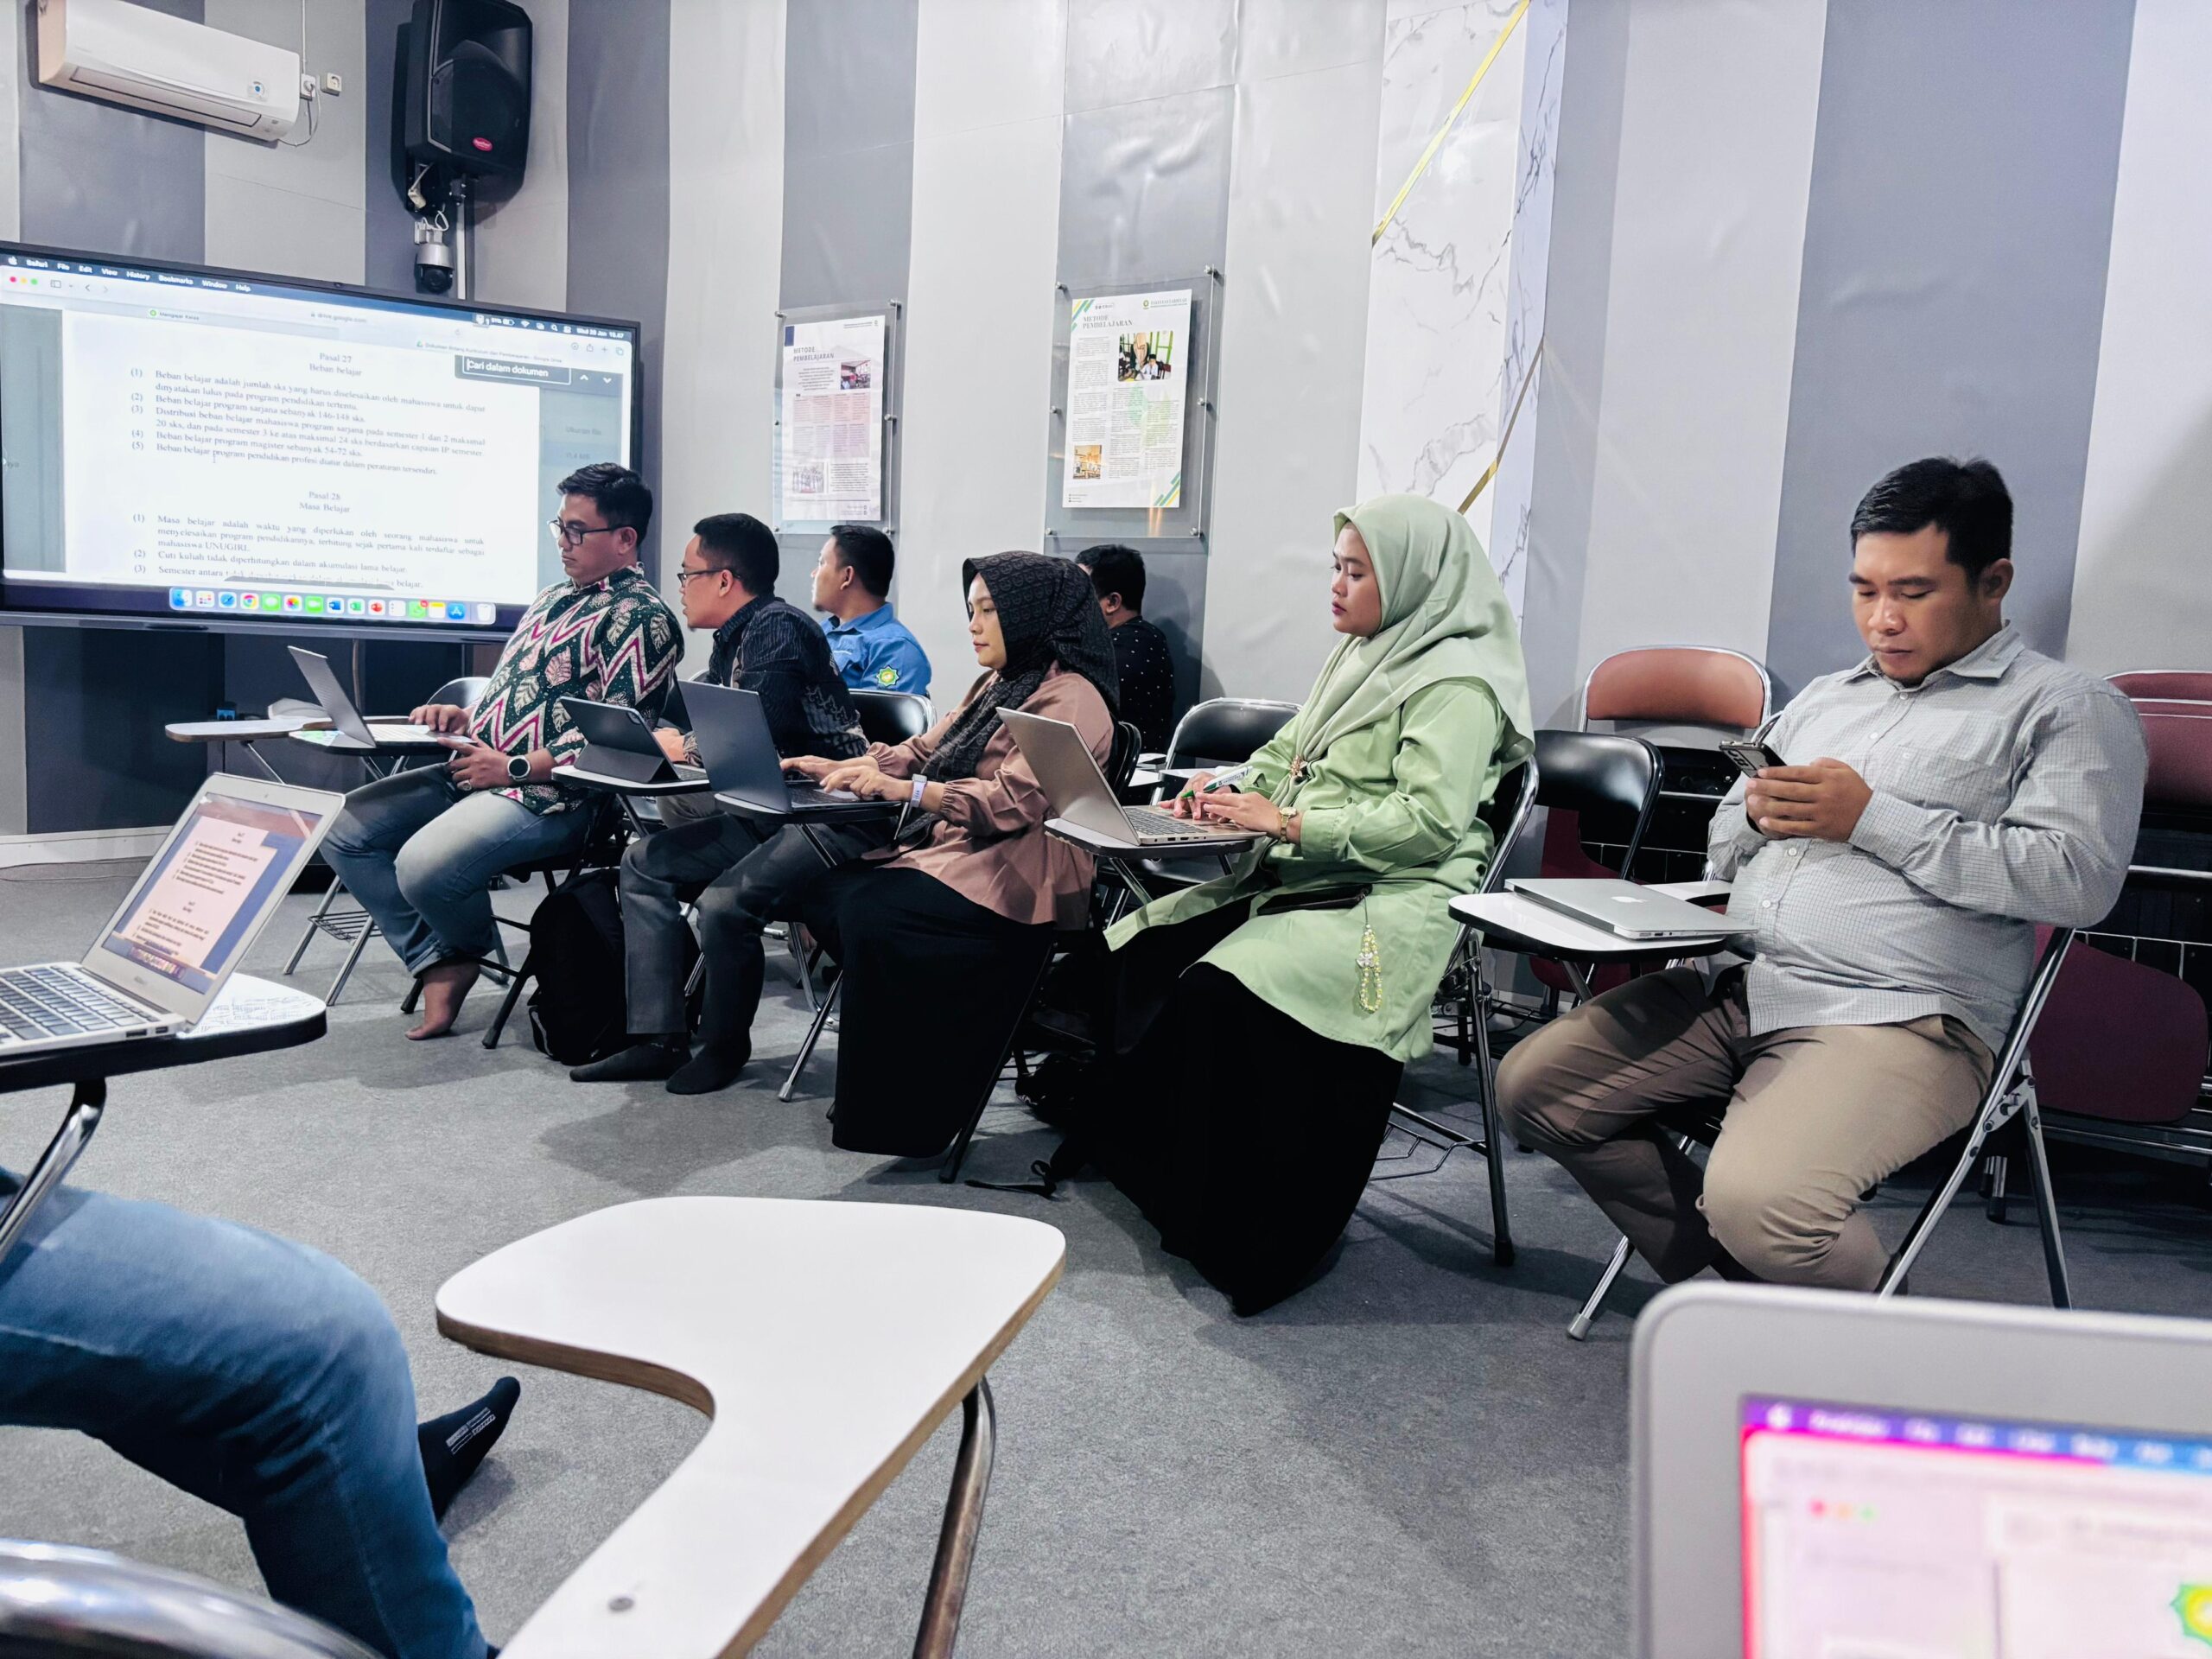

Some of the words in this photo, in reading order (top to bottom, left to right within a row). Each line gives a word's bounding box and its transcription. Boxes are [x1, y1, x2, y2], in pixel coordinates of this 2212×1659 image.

[26, 259, 48, 268] Safari
[126, 270, 150, 281] History
[158, 274, 194, 285] Bookmarks
[201, 279, 228, 289] Window
[235, 283, 251, 292] Help
[1083, 320, 1133, 328] PEMBELAJARAN
[319, 353, 340, 363] Pasal
[468, 359, 484, 370] Cari
[486, 363, 510, 373] dalam
[512, 365, 549, 377] dokumen
[793, 353, 835, 362] PEMBELAJARAN
[309, 363, 334, 372] Beban
[336, 365, 362, 377] belajar
[130, 368, 143, 378] (1)
[156, 370, 181, 380] Beban
[184, 373, 211, 384] belajar
[214, 378, 240, 386] adalah
[243, 380, 271, 389] jumlah
[289, 386, 308, 395] yang
[310, 386, 332, 397] harus
[334, 389, 380, 401] diselesaikan
[382, 395, 398, 404] oleh
[401, 397, 442, 408] mahasiswa
[442, 402, 463, 410] untuk
[465, 404, 486, 413] dapat
[156, 383, 200, 394] dinyatakan
[203, 387, 222, 397] lulus
[225, 391, 244, 400] pada
[246, 393, 280, 404] program
[282, 397, 327, 407] pendidikan
[131, 393, 143, 403] (2)
[156, 395, 181, 404] Beban
[184, 397, 211, 408] belajar
[213, 402, 247, 412] program
[250, 404, 277, 414] sarjana
[280, 407, 315, 418] sebanyak
[131, 404, 143, 414] (3)
[156, 407, 196, 418] Distribusi
[199, 410, 223, 421] beban
[226, 413, 253, 424] belajar
[256, 416, 299, 427] mahasiswa
[302, 422, 334, 431] program
[337, 425, 363, 435] sarjana
[365, 429, 384, 437] pada
[386, 430, 418, 440] semester
[428, 433, 442, 442] dan
[450, 436, 486, 446] maksimal
[132, 429, 143, 439] (4)
[156, 431, 181, 441] Beban
[185, 434, 212, 444] belajar
[214, 438, 248, 448] program
[251, 441, 284, 450] magister
[286, 443, 322, 454] sebanyak
[204, 423, 223, 433] pada
[226, 426, 259, 436] semester
[270, 429, 279, 437] ke
[299, 433, 336, 442] maksimal
[365, 440, 410, 450] berdasarkan
[411, 444, 439, 454] capaian
[132, 442, 143, 450] (5)
[156, 443, 181, 453] Beban
[184, 445, 211, 455] belajar
[213, 449, 245, 458] program
[248, 452, 289, 462] pendidikan
[291, 455, 317, 465] profesi
[319, 458, 340, 467] diatur
[366, 462, 401, 473] peraturan
[308, 491, 328, 500] Pasal
[299, 502, 320, 511] Masa
[323, 504, 350, 513] Belajar
[133, 514, 145, 524] (1)
[188, 518, 214, 527] belajar
[314, 526, 353, 536] diperlukan
[384, 532, 411, 541] seorang
[419, 535, 458, 543] mahasiswa
[158, 529, 217, 539] menyelesaikan
[220, 532, 253, 542] program
[319, 540, 352, 549] terhitung
[378, 543, 406, 551] pertama
[426, 546, 455, 555] terdaftar
[458, 548, 484, 556] sebagai
[158, 540, 202, 549] mahasiswa
[134, 550, 145, 558] (2)
[180, 552, 204, 561] kuliah
[231, 556, 289, 567] diperhitungkan
[319, 562, 358, 570] akumulasi
[134, 565, 146, 574] (3)
[159, 566, 196, 576] Semester
